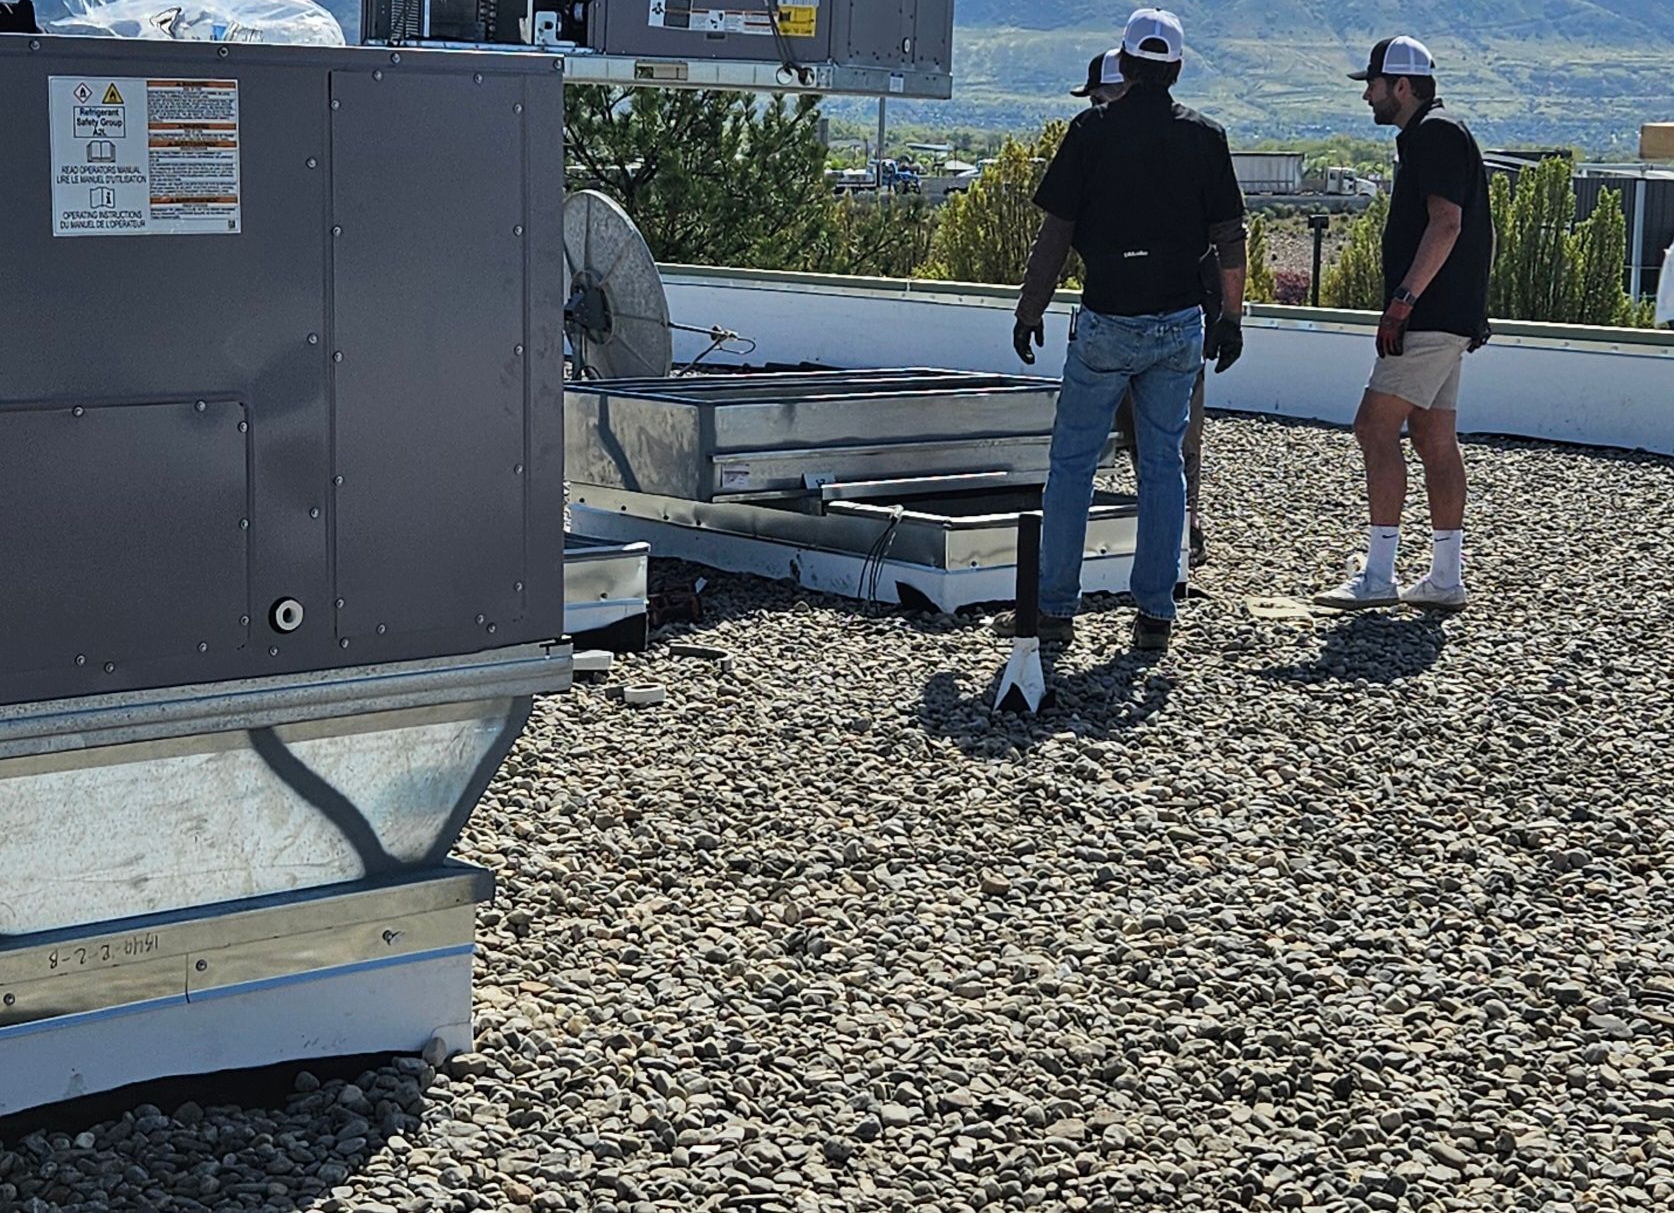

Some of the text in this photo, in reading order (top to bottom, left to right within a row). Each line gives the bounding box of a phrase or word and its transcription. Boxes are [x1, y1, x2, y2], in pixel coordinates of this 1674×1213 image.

[80, 106, 119, 118] Refrigerant
[77, 117, 123, 128] Safety Group
[61, 165, 79, 174] READ
[117, 166, 141, 174] MANUAL
[57, 175, 70, 184] LIRE
[80, 175, 105, 184] MANUEL
[63, 210, 98, 220] OPERATING
[99, 210, 142, 219] INSTRUCTIONS
[60, 220, 70, 229] DU
[71, 220, 95, 229] MANUEL
[96, 220, 105, 228] DE
